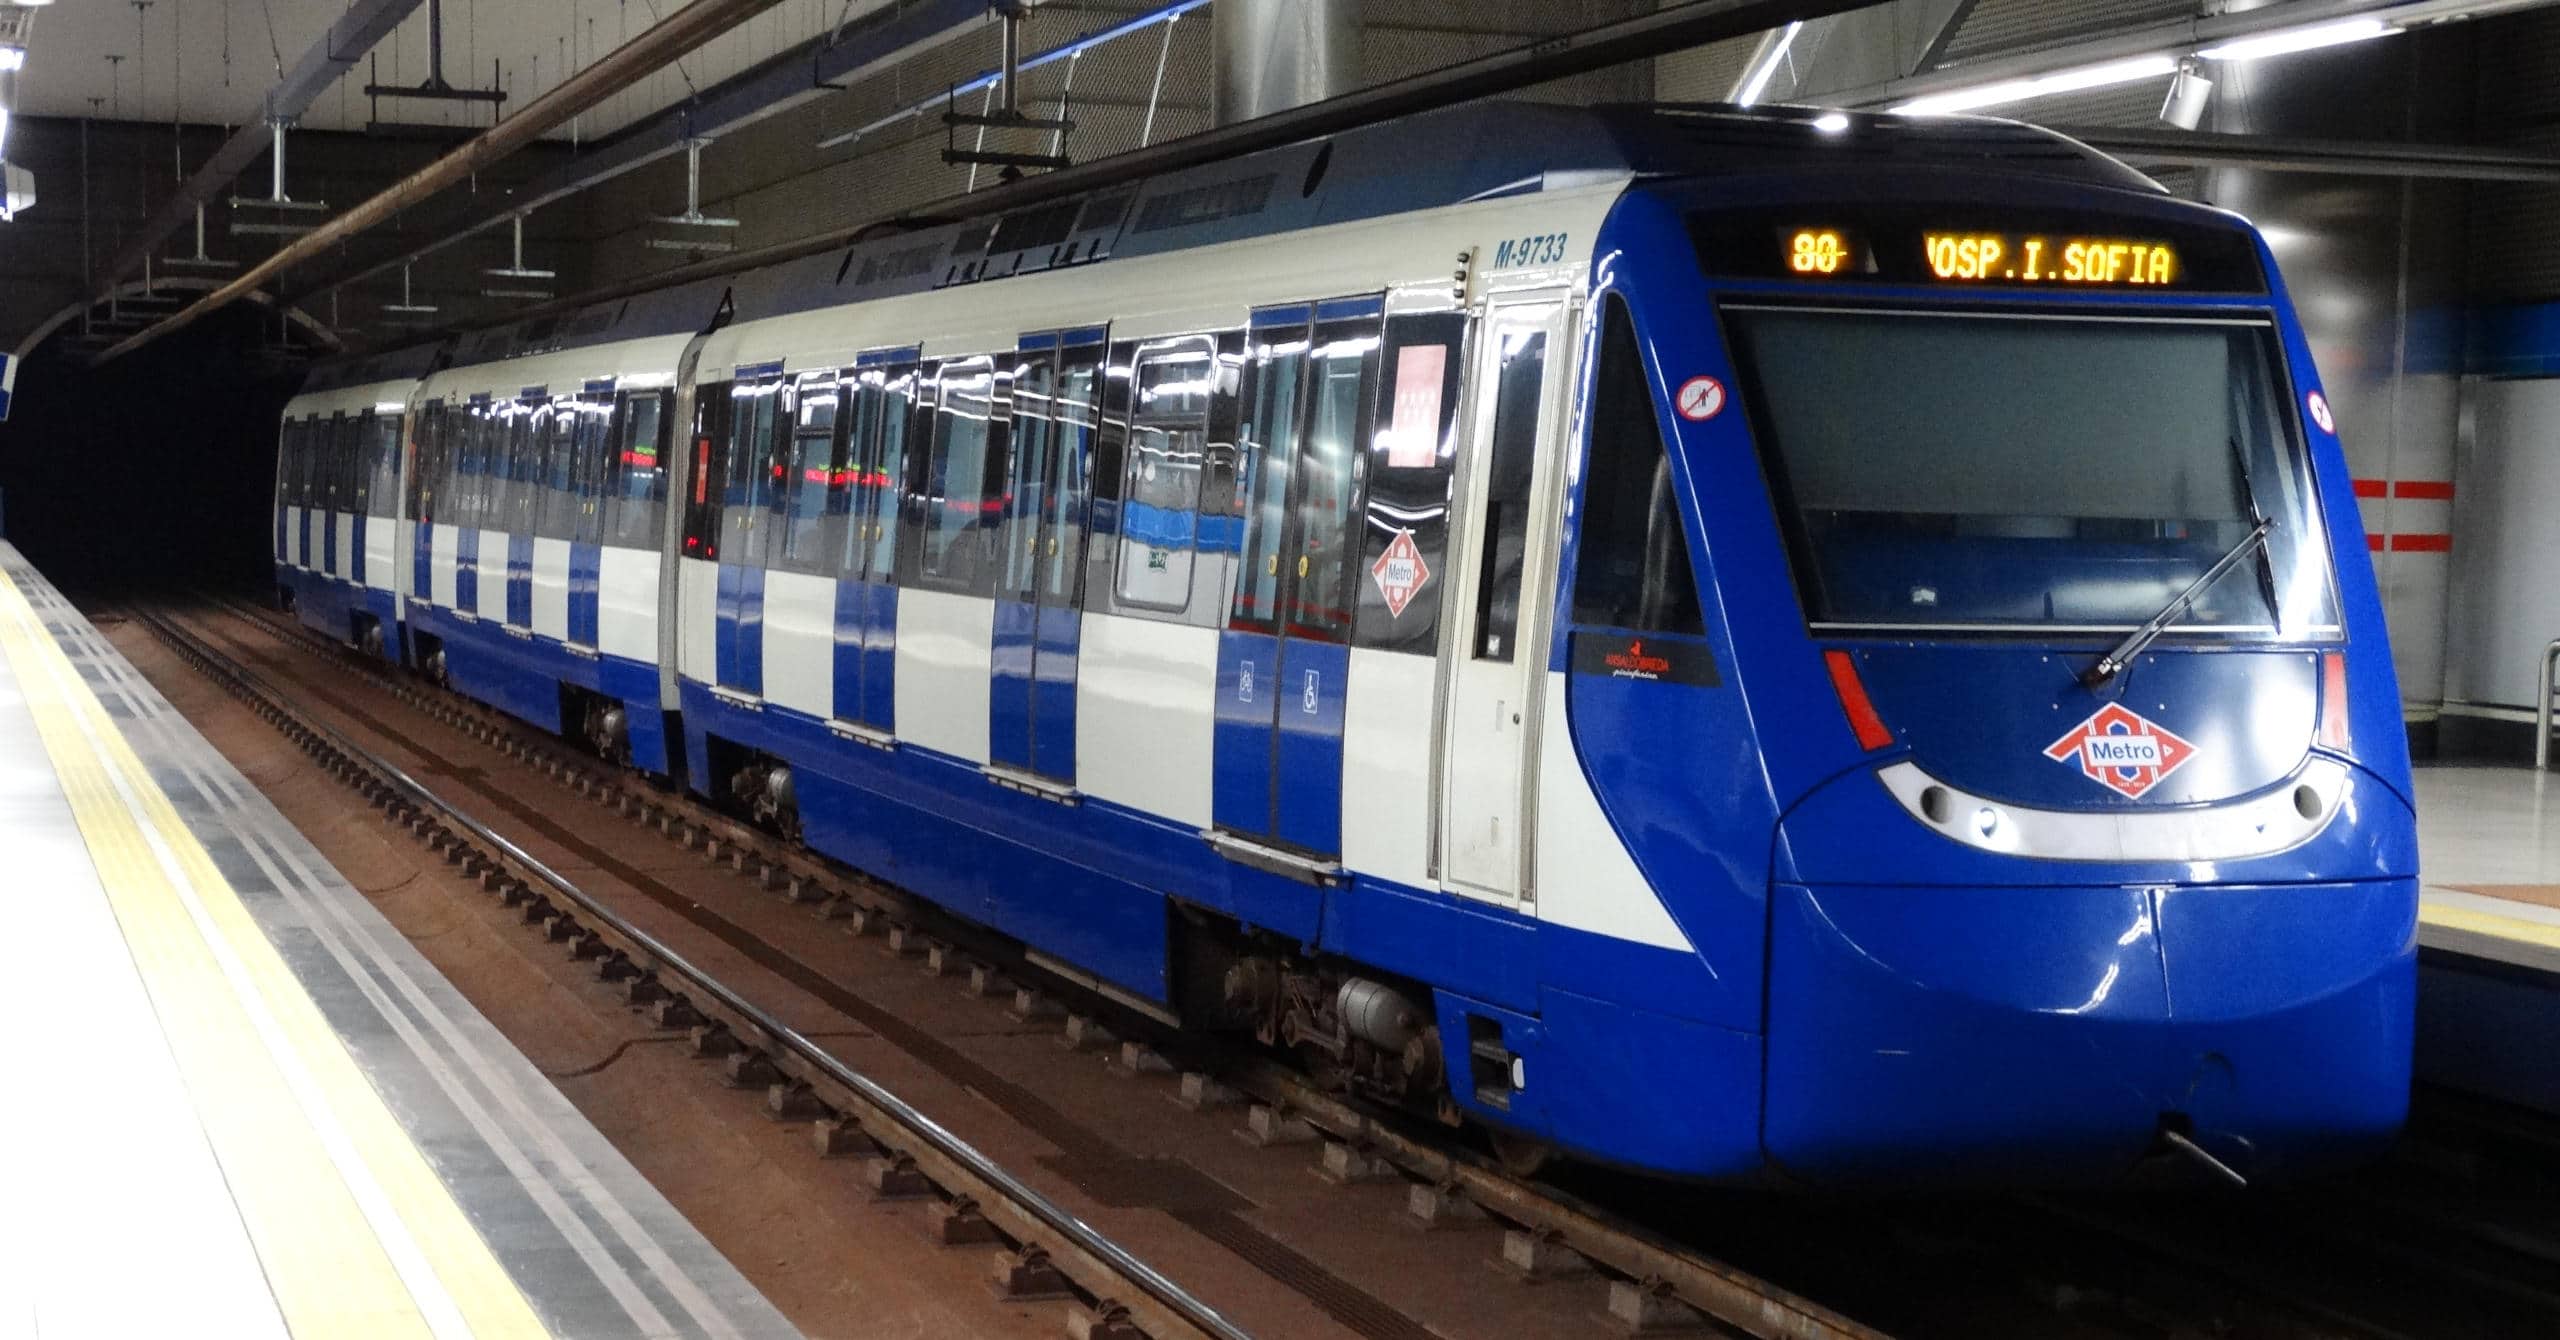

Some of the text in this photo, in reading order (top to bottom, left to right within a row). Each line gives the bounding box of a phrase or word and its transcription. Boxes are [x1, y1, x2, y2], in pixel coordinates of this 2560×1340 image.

[1494, 232, 1568, 269] M-9733
[1387, 563, 1412, 582] Metro
[2091, 742, 2155, 760] Metro
